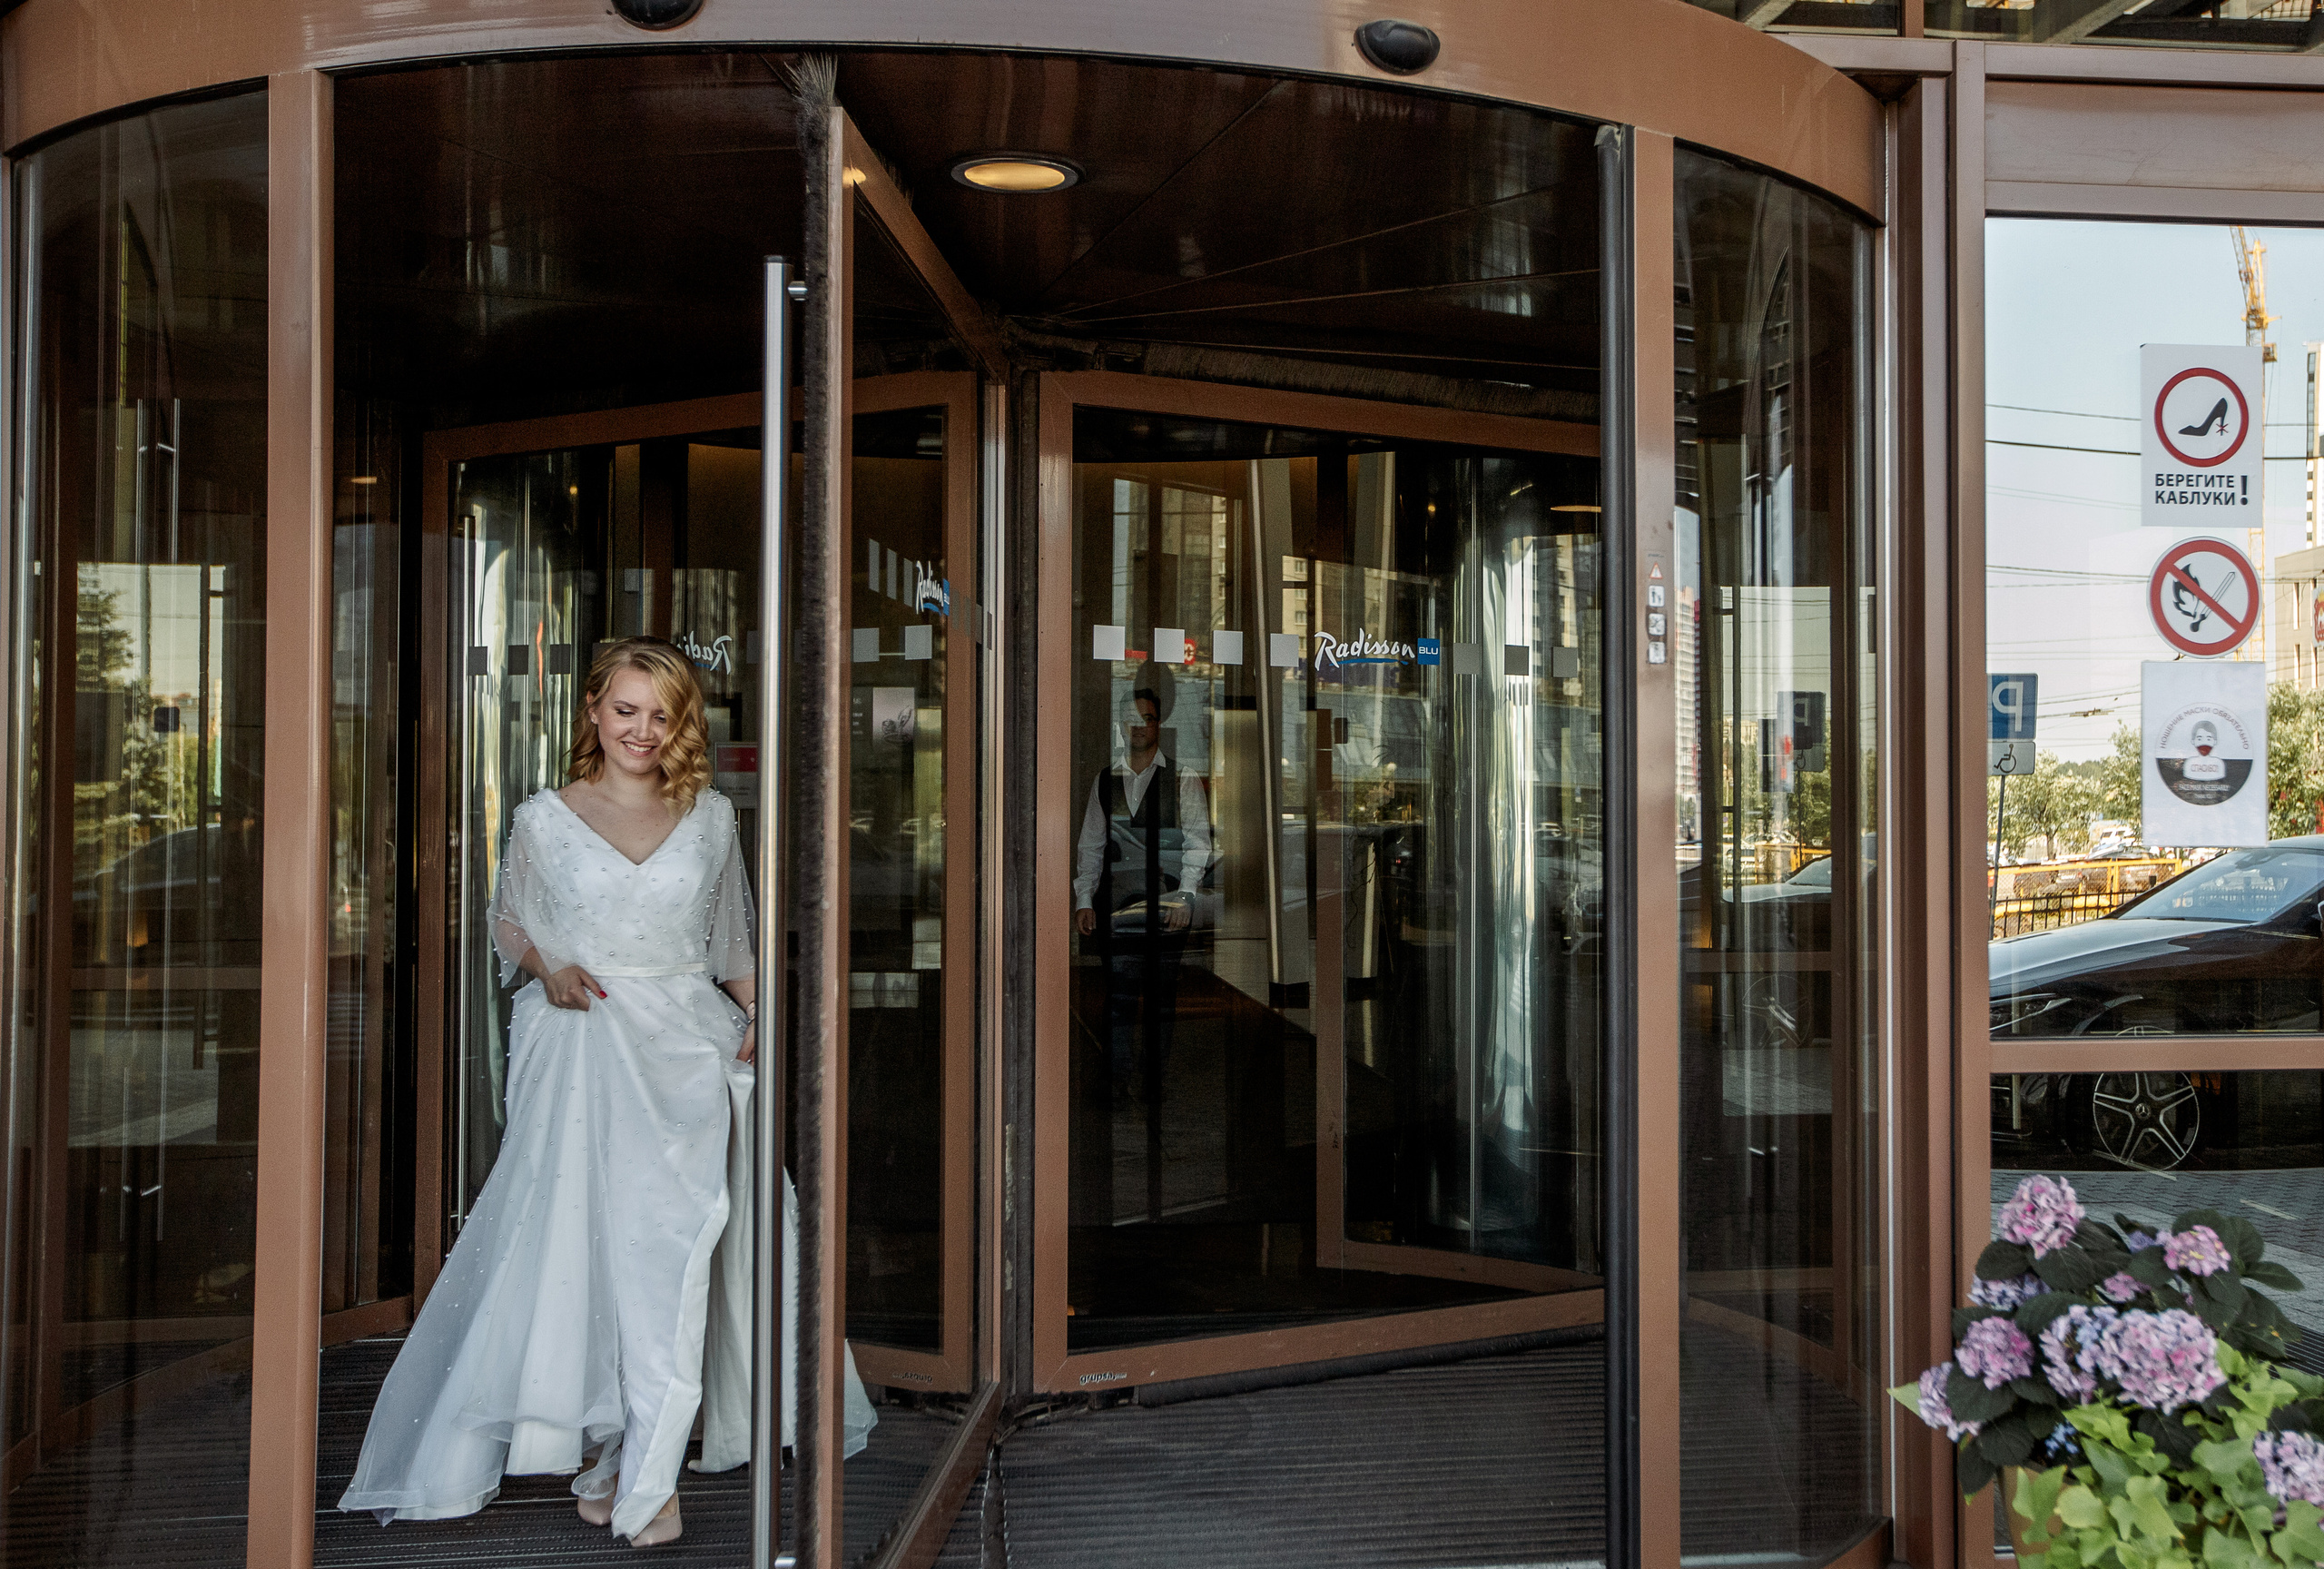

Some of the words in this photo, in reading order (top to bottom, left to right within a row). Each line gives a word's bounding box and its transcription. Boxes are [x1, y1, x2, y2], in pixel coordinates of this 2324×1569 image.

[2155, 473, 2235, 488] БЕРЕГИТЕ
[2155, 490, 2235, 506] КАБЛУКИ
[1315, 627, 1415, 671] Radisson
[1419, 646, 1439, 656] BLU
[2160, 714, 2184, 749] НОШЕНИЕ
[2183, 706, 2211, 717] МАСКИ
[2212, 708, 2250, 750] ОБЯЗАТЕЛЬНО
